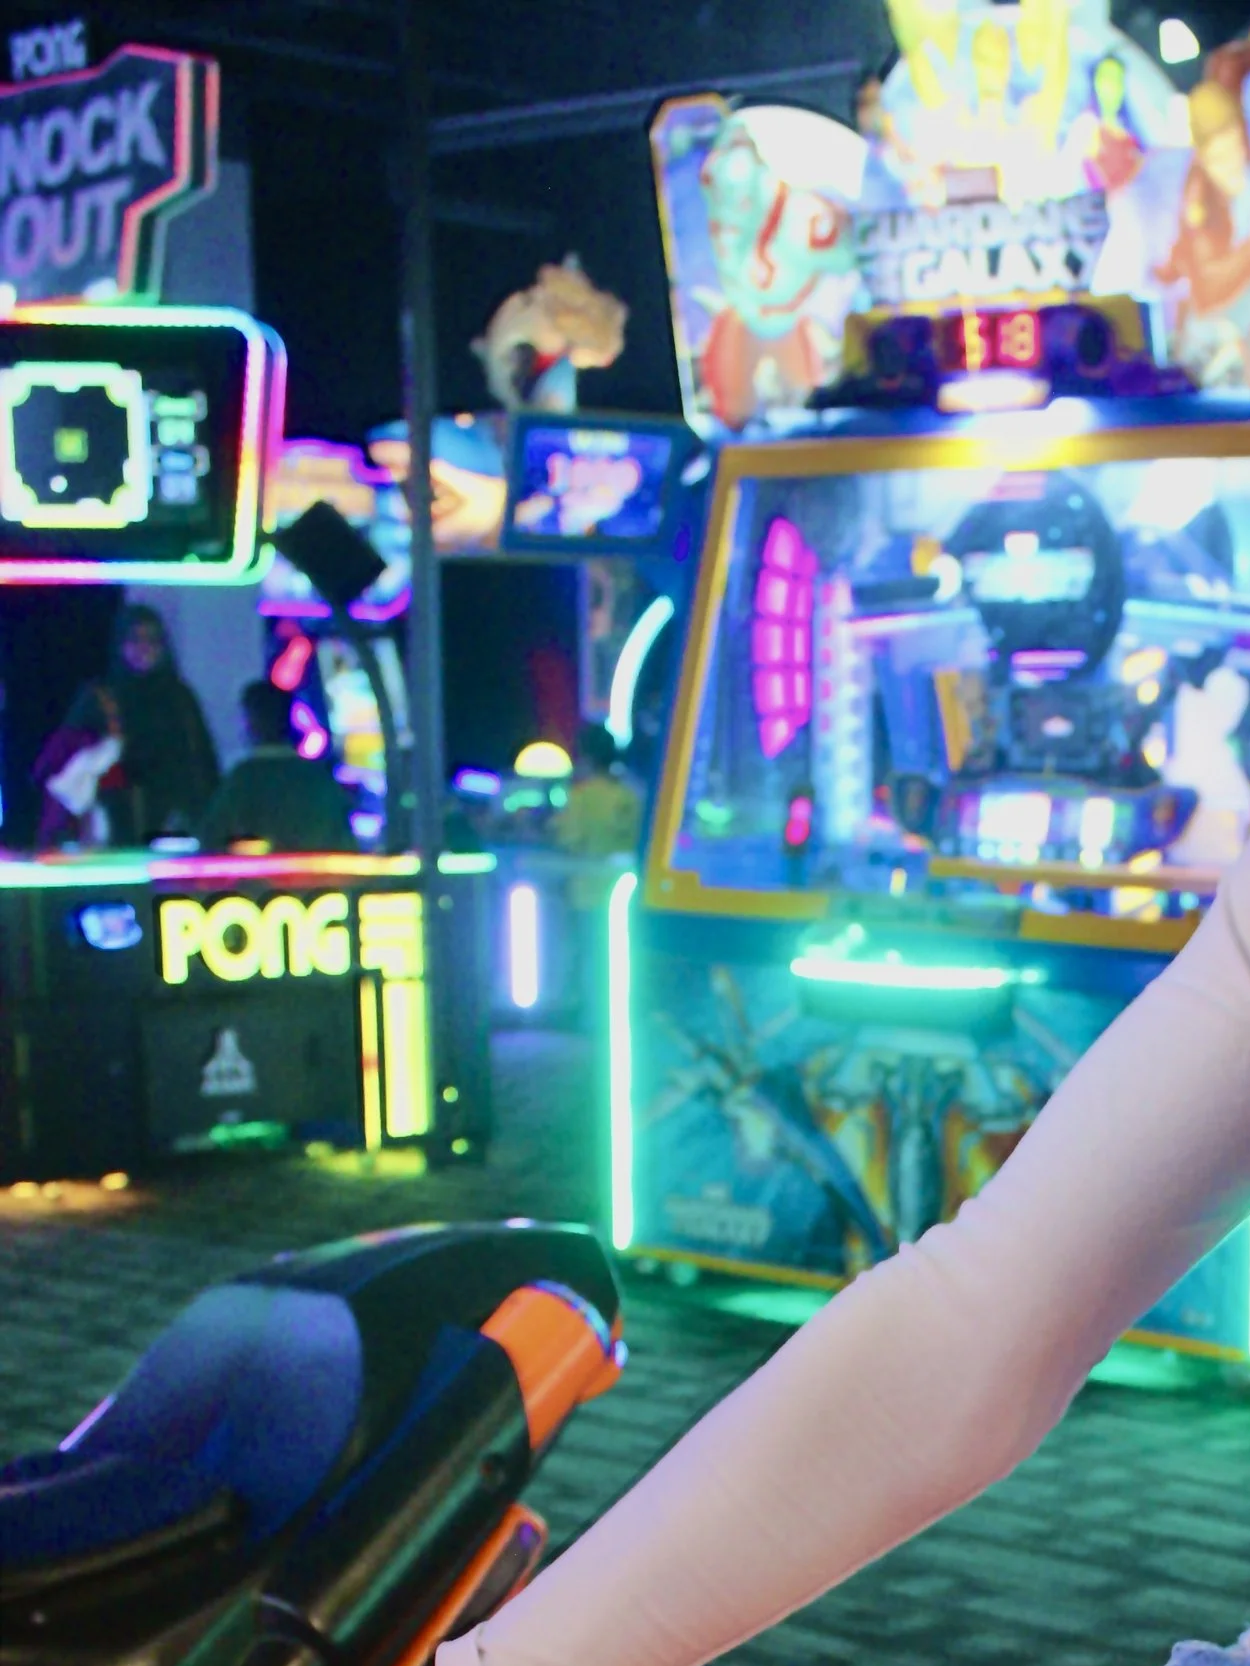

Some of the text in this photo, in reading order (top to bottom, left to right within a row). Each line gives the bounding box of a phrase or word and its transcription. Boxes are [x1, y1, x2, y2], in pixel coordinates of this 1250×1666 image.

[10, 20, 87, 82] PONG
[0, 80, 167, 198] NOCK
[3, 177, 134, 278] OUT
[160, 892, 351, 985] PONG
